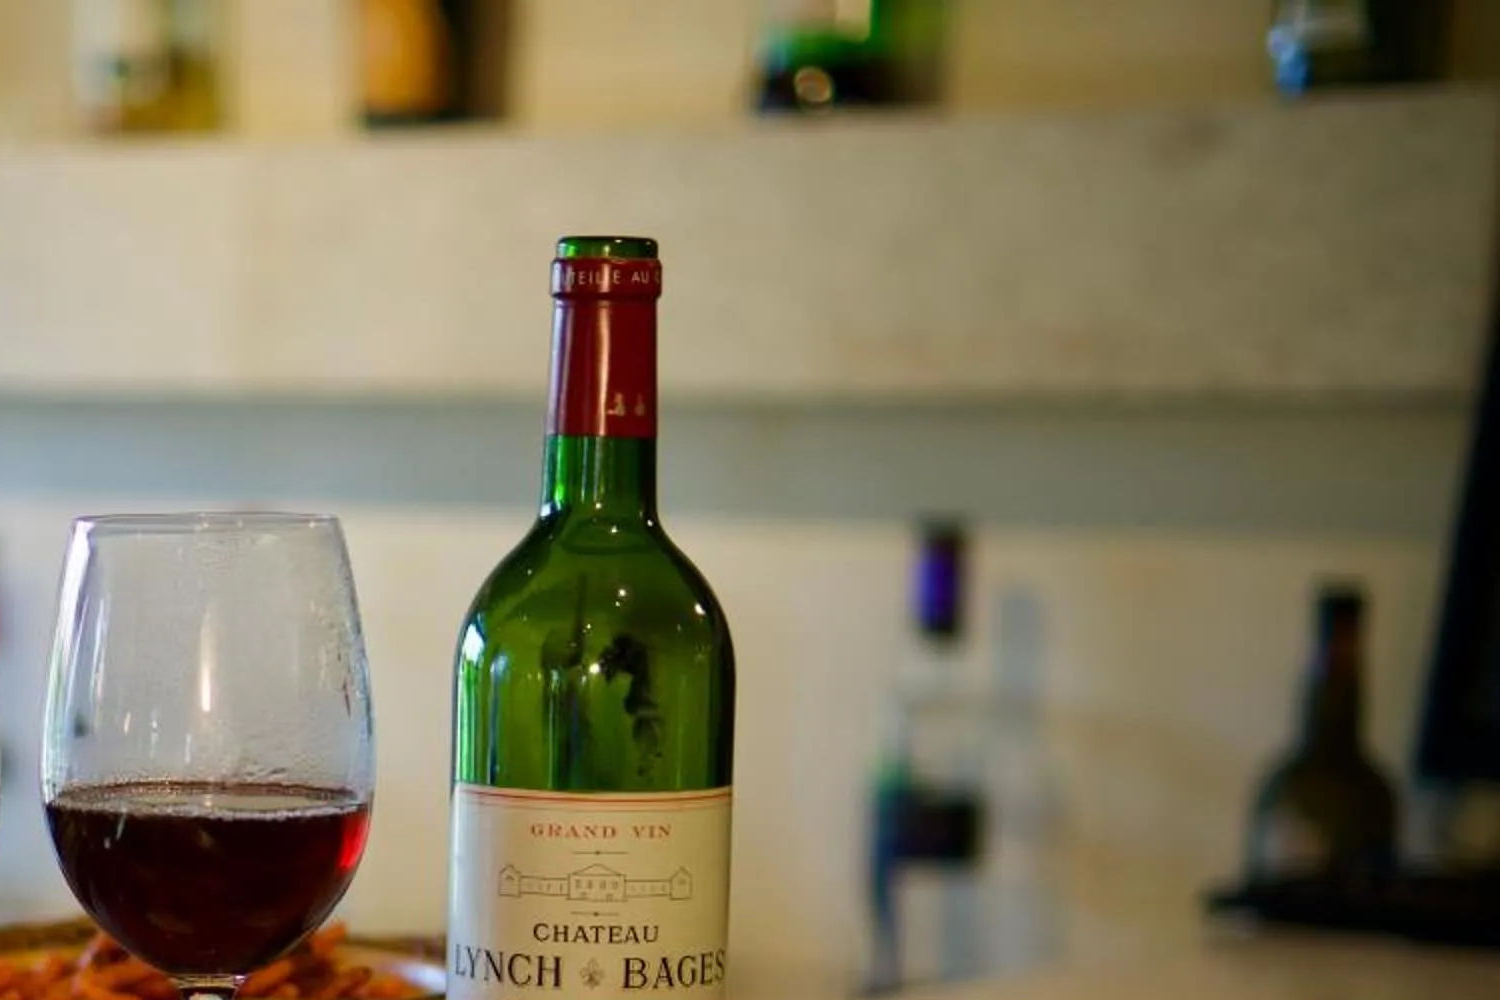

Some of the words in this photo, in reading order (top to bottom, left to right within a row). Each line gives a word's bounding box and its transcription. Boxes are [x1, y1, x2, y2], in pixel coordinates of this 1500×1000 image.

[631, 271, 650, 284] AU
[530, 823, 617, 839] GRAND
[632, 824, 672, 839] VIN
[532, 922, 660, 945] CHATEAU
[454, 944, 563, 988] LYNCH
[621, 948, 726, 990] BAGES
